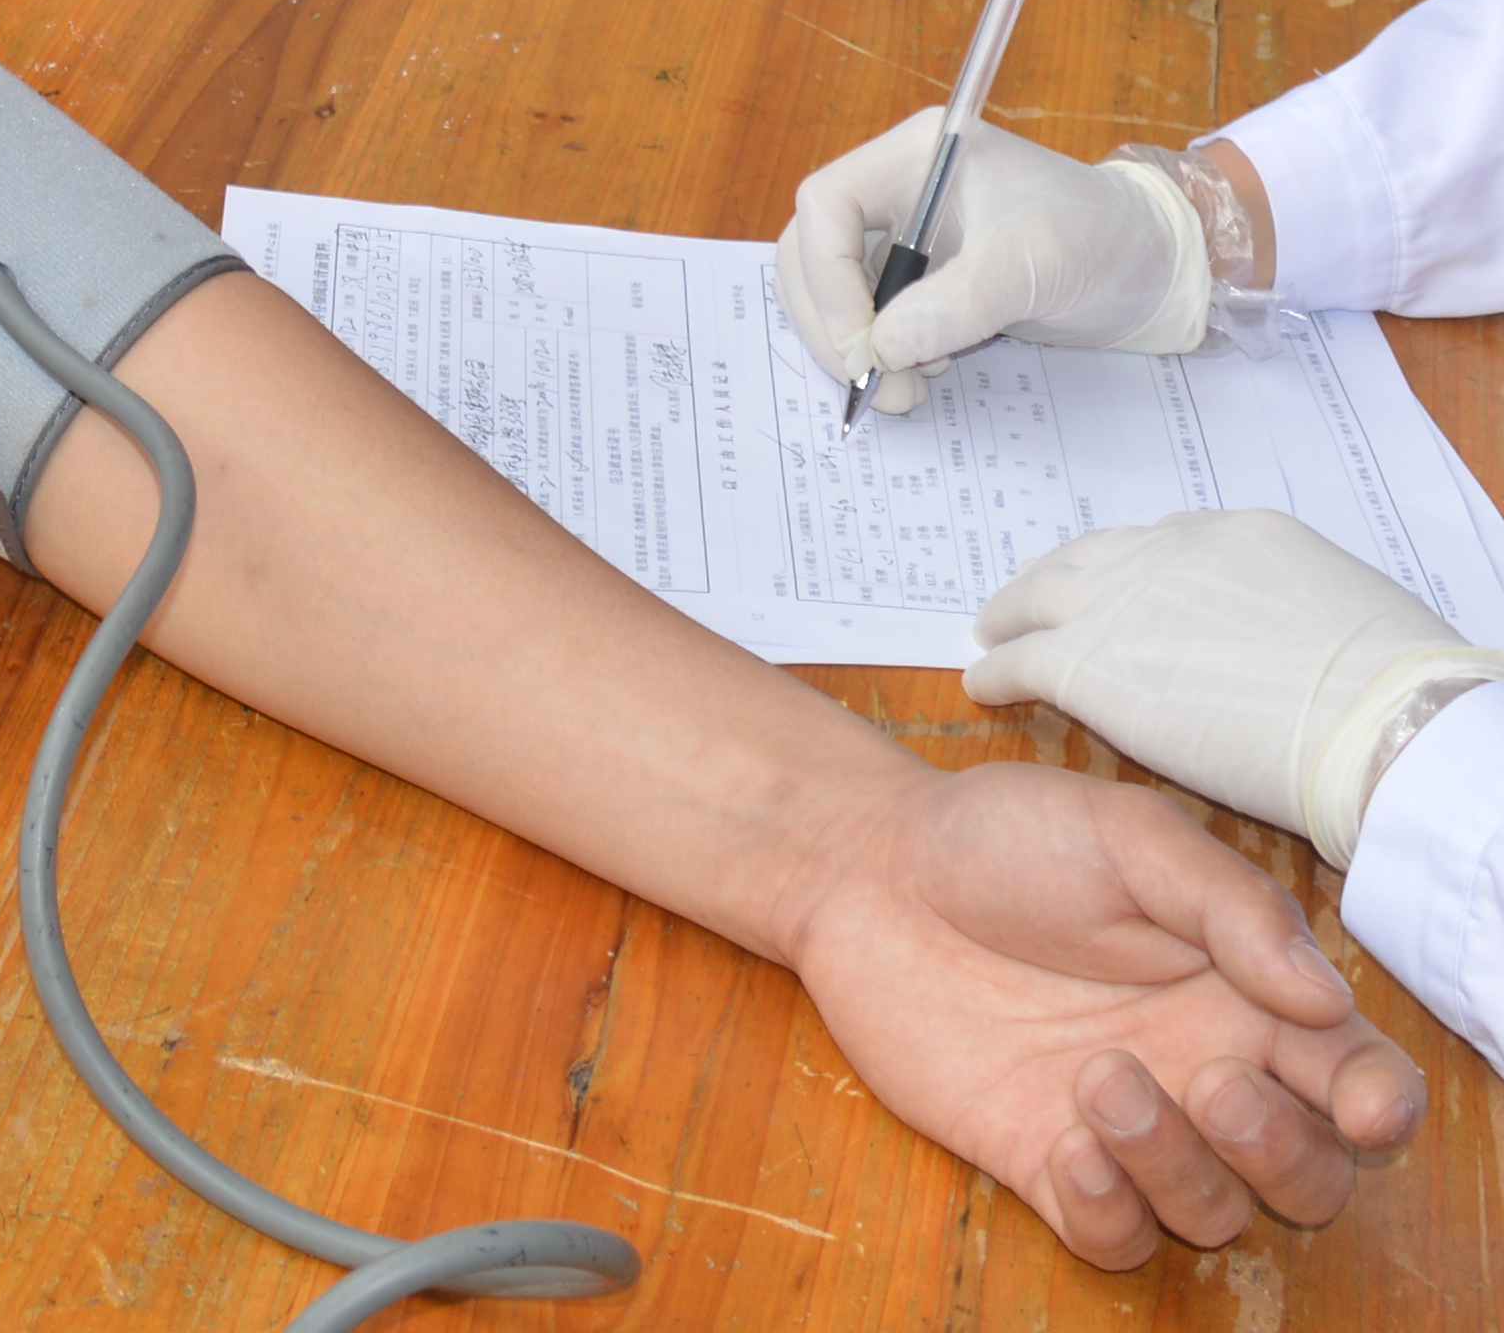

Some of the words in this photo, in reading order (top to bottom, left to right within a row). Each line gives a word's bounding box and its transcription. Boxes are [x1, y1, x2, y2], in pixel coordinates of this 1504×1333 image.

[711, 360, 738, 490] 以下由工作人员记录
